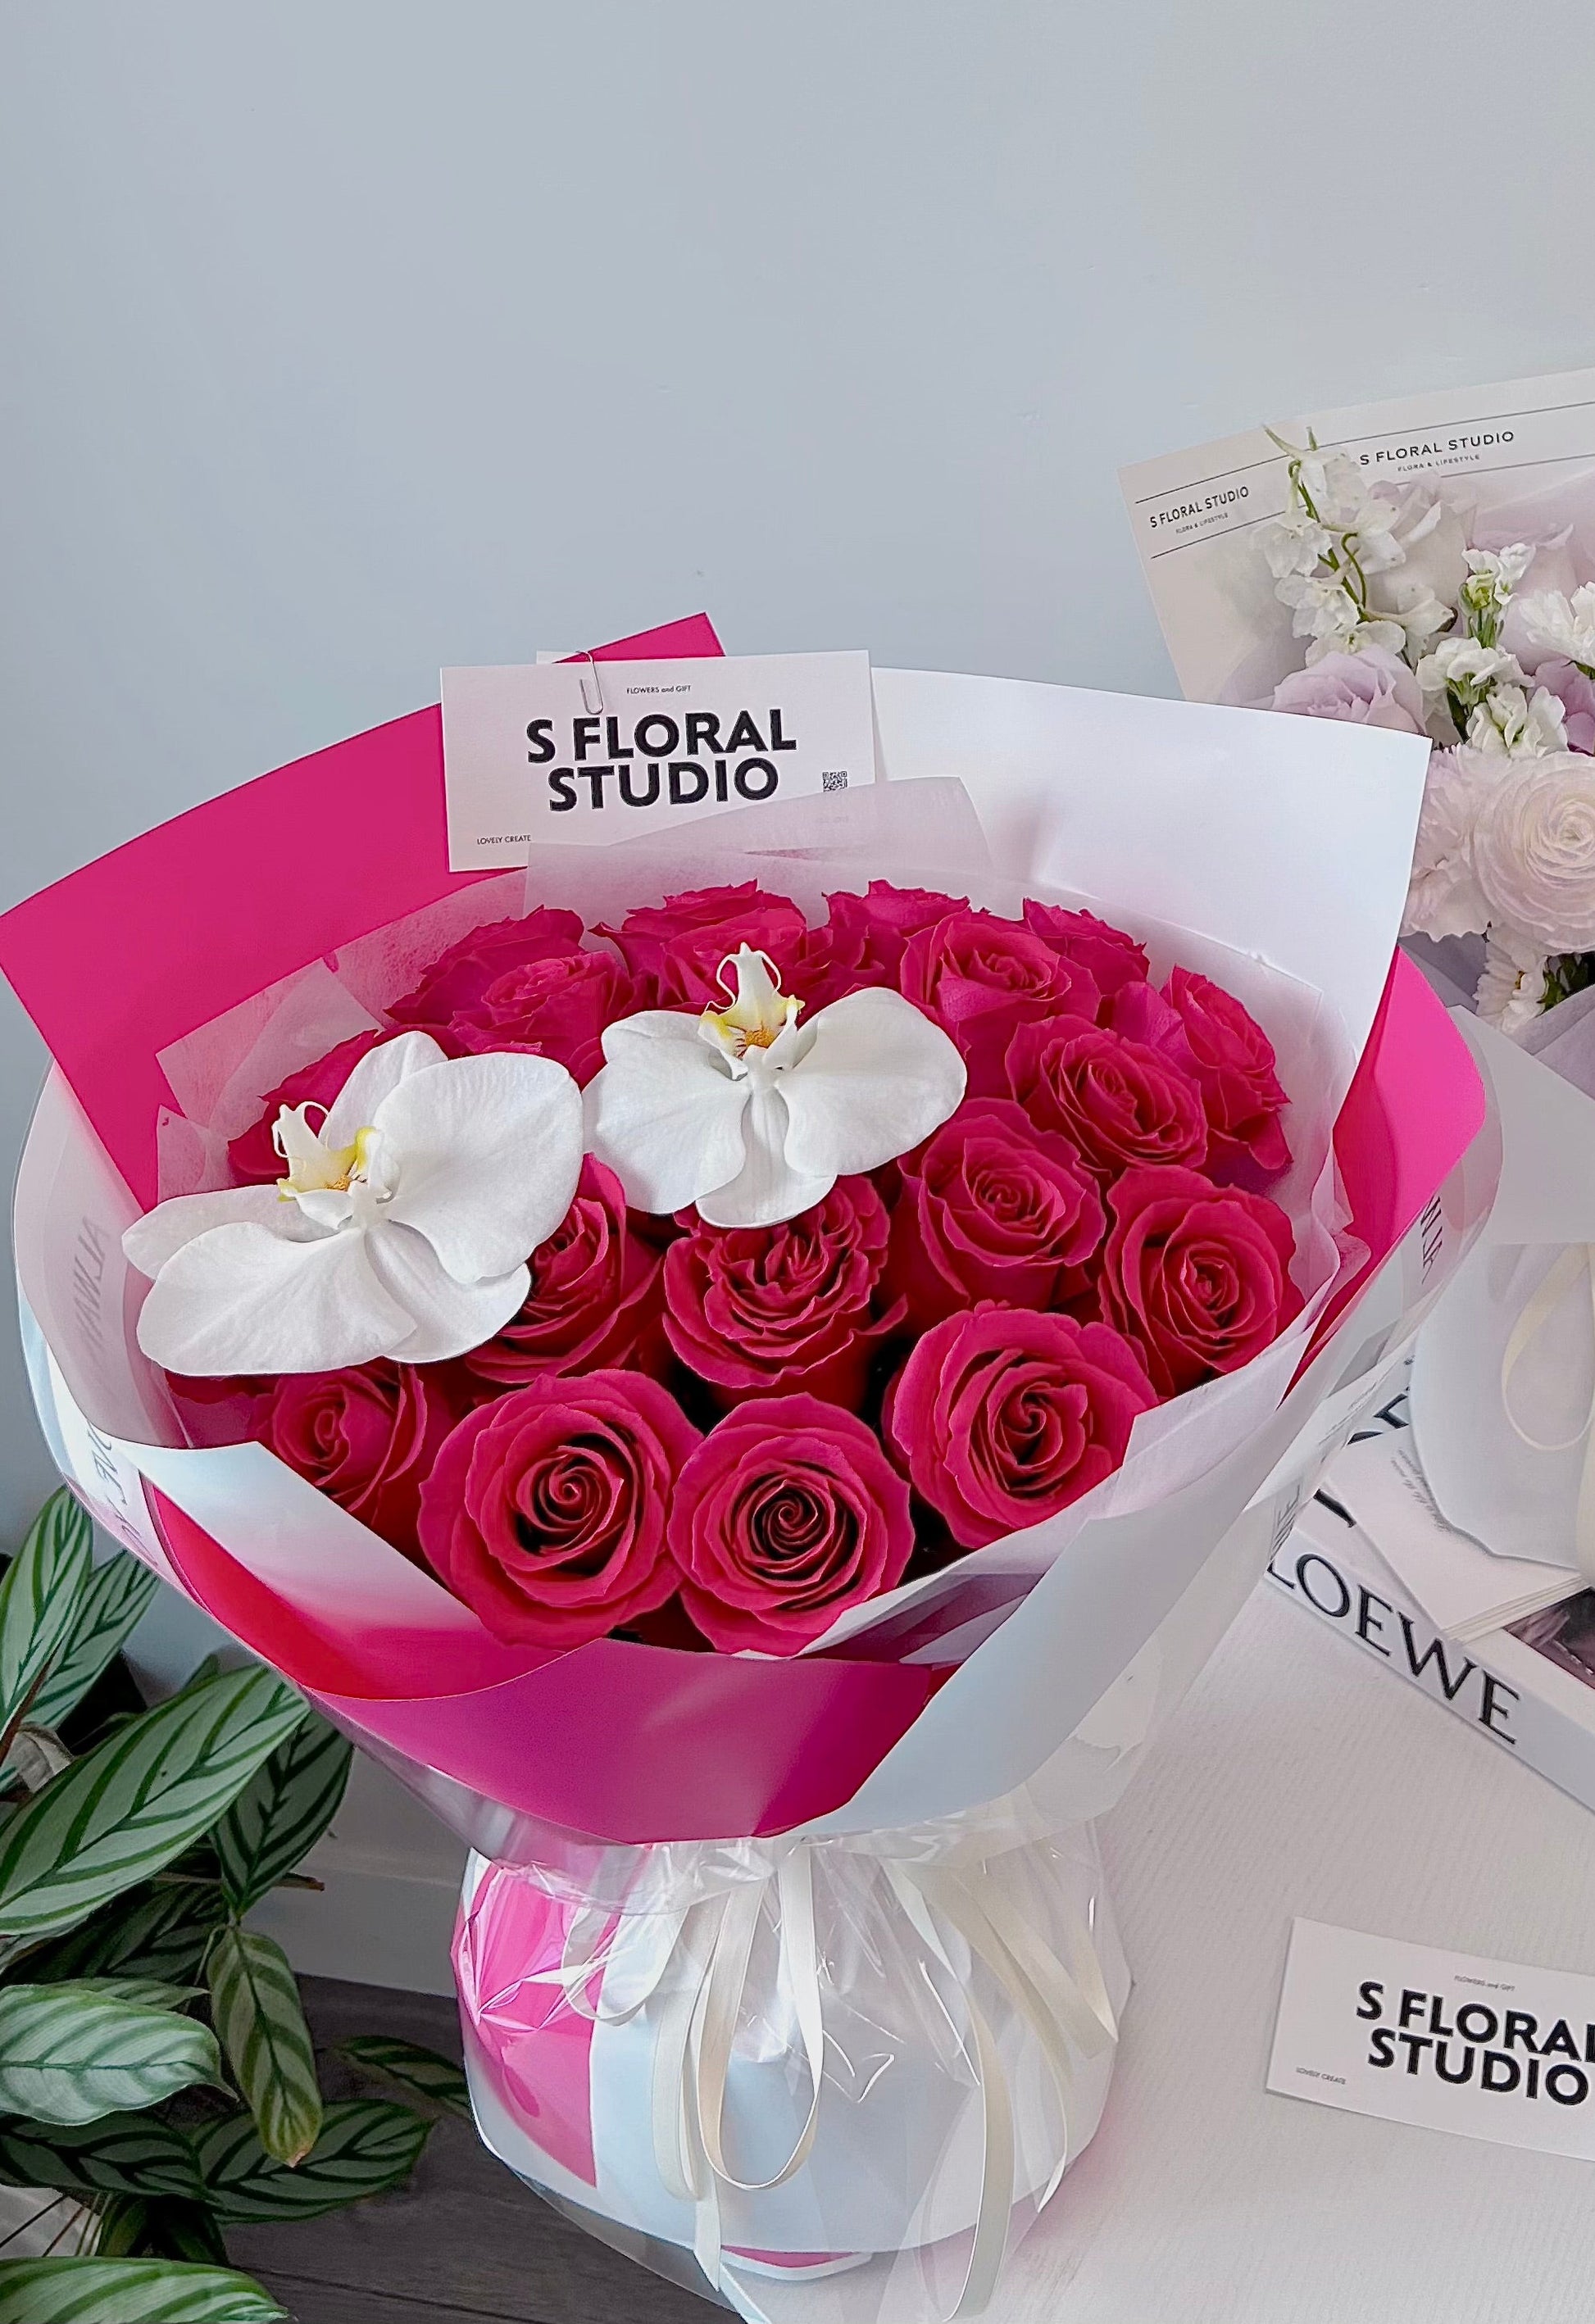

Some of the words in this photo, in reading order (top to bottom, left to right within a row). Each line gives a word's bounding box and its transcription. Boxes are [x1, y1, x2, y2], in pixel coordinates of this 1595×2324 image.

[1360, 455, 1370, 465] S
[1376, 443, 1443, 462] FLORAL
[1448, 431, 1514, 451] STUDIO
[1150, 516, 1157, 528] S
[1159, 502, 1202, 524] FLORAL
[1205, 486, 1249, 509] STUDIO
[527, 719, 556, 763] S
[573, 709, 797, 760] FLORAL
[548, 757, 779, 811] STUDIO
[1267, 1554, 1520, 1745] LOEWE
[1356, 1981, 1384, 2020] S
[1368, 2028, 1588, 2106] STUDIO
